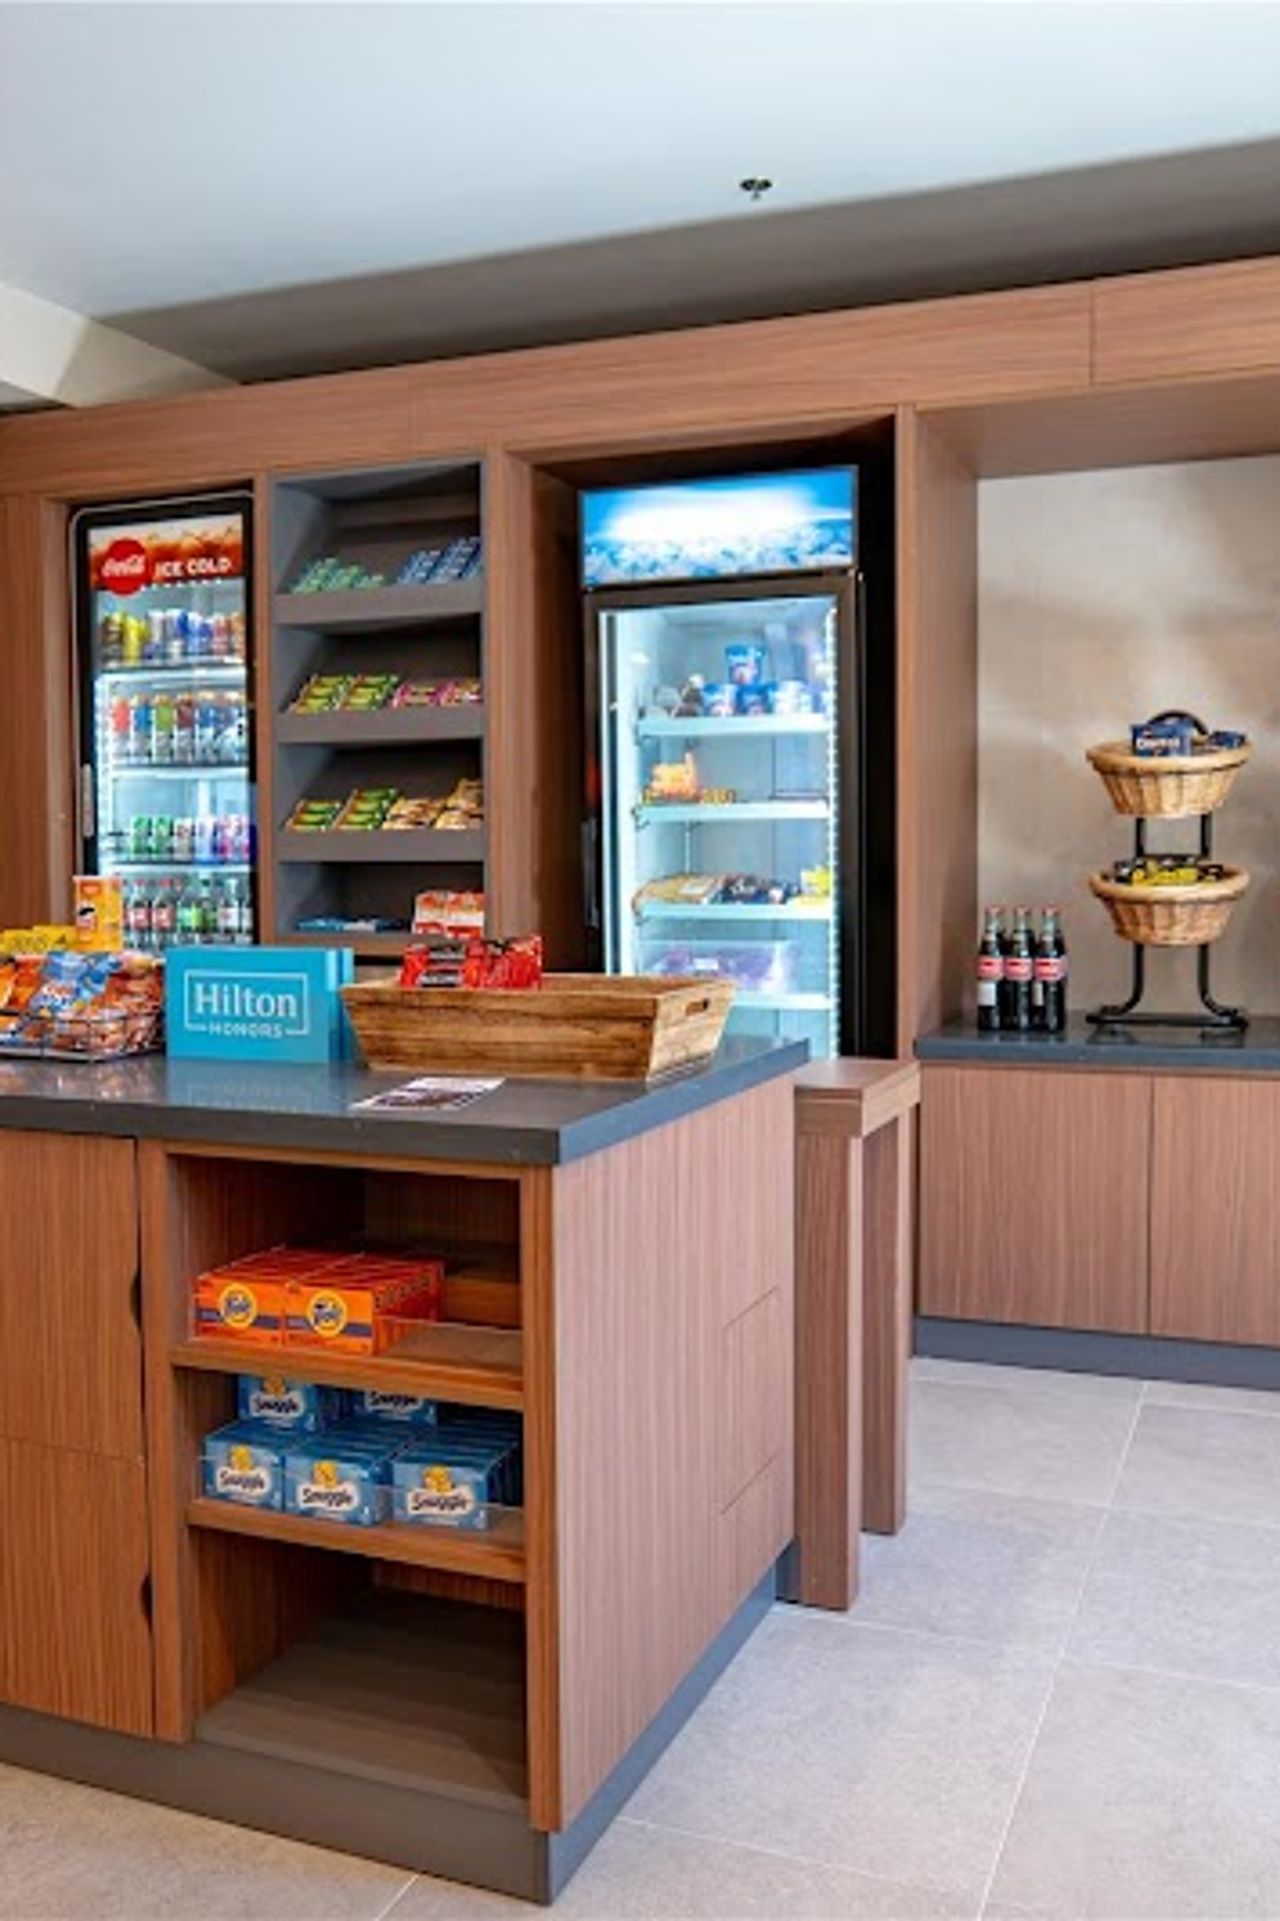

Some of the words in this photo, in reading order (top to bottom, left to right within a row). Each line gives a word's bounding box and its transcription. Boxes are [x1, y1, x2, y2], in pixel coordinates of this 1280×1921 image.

[187, 556, 232, 575] COLD
[195, 983, 298, 1018] Hilton
[208, 1021, 283, 1039] HONORS
